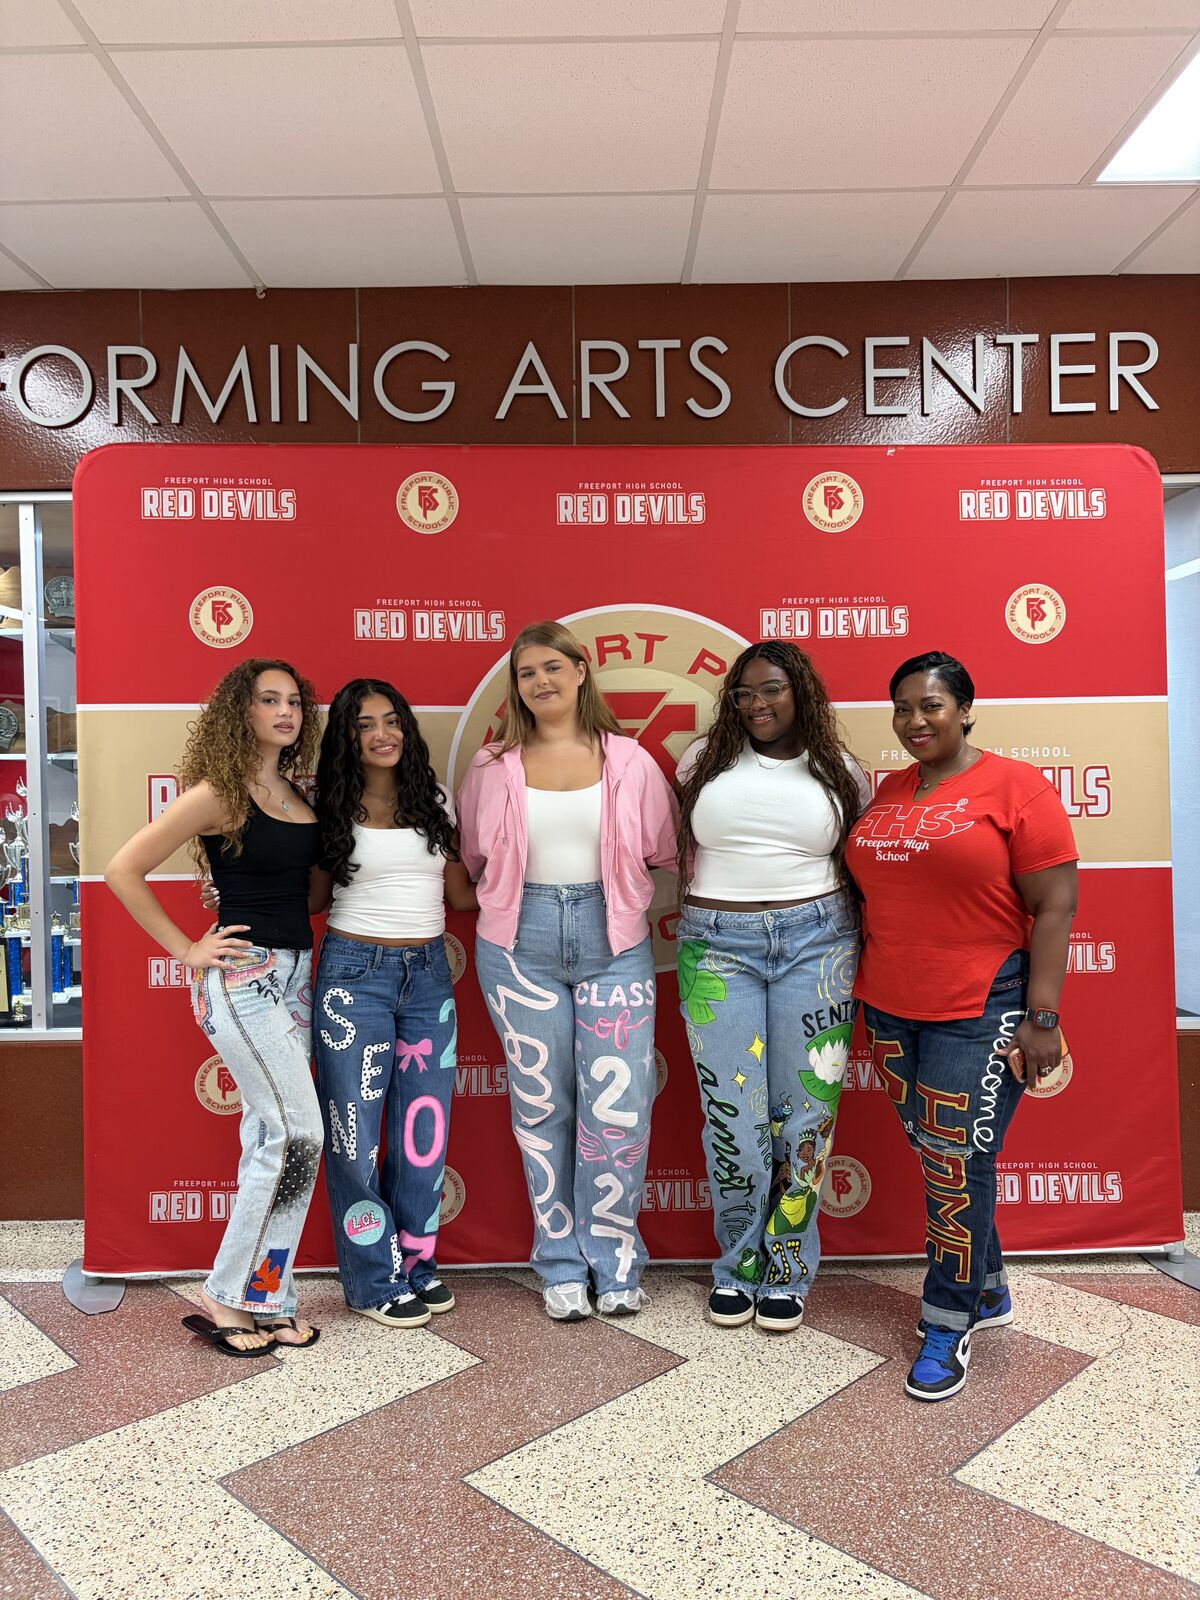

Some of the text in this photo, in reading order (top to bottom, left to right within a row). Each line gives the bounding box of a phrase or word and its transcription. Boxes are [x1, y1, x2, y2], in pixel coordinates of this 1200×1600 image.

[0, 332, 1161, 427] ORMING ARTS CENTER
[238, 478, 273, 486] SCHOOL
[400, 476, 454, 511] FREEPORT PUBLIC
[578, 482, 622, 490] FREEPORT
[625, 482, 646, 490] HIGH
[807, 476, 859, 511] FREEPORT PUBLIC
[980, 479, 1023, 487] FREEPORT
[1050, 478, 1083, 486] SCHOOL
[141, 488, 297, 521] RED DEVILS
[556, 492, 706, 525] RED DEVILS
[959, 488, 1107, 521] RED DEVILS
[407, 515, 449, 529] SCHOOLS
[813, 514, 854, 528] SCHOOLS
[194, 591, 249, 625] FREEPORT PUBLIC
[424, 599, 445, 607] HIGH
[782, 597, 826, 605] FREEPORT
[852, 596, 886, 604] SCHOOL
[1010, 588, 1062, 622] FREEPORT PUBLIC
[200, 630, 243, 644] SCHOOLS
[354, 608, 505, 642] RED DEVILS
[760, 606, 909, 639] RED DEVILS
[1015, 626, 1056, 640] SCHOOLS
[1011, 747, 1071, 758] SCHOOL
[848, 799, 974, 839] FHS
[855, 836, 929, 852] Freeport High
[875, 850, 910, 861] School
[574, 979, 655, 1008] CLASS
[576, 1008, 653, 1050] of
[199, 1057, 223, 1093] FREEPO
[453, 1064, 511, 1097] VILS
[206, 1097, 243, 1111] SCHOOL
[696, 1061, 757, 1199] almost
[173, 1180, 217, 1188] FREEPORT
[657, 1168, 691, 1176] SCHOOL
[849, 1162, 867, 1193] PUBLIC
[995, 1171, 1123, 1204] ED DEVILS
[149, 1190, 204, 1223] RED
[640, 1179, 712, 1211] EVILS
[821, 1199, 862, 1213] SCHOOLS
